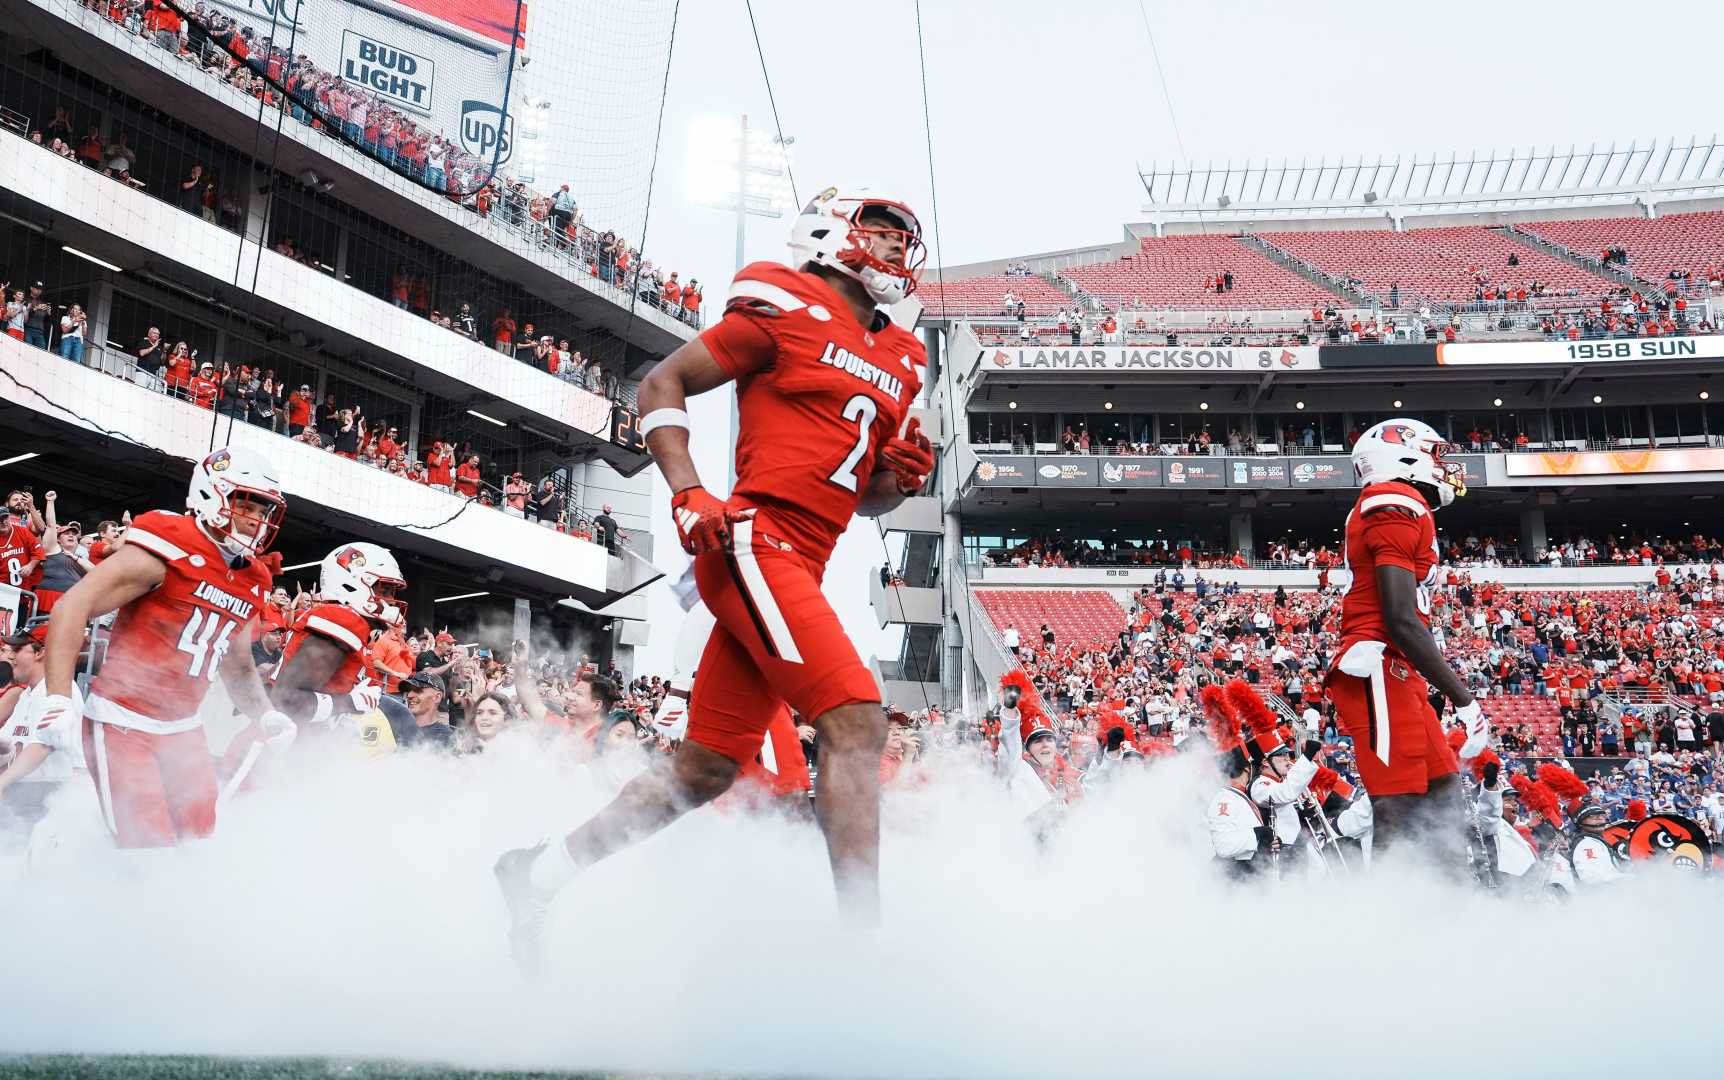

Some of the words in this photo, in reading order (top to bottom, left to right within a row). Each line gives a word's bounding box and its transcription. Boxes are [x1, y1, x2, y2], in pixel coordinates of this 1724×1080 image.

[249, 0, 305, 26] NC
[359, 39, 418, 76] BUD
[345, 58, 426, 104] LIGHT
[1018, 350, 1107, 368] LAMAR
[1114, 350, 1233, 368] JACKSON
[1258, 350, 1273, 368] 8
[1567, 343, 1631, 359] 1958
[1641, 340, 1696, 356] SUN
[828, 394, 878, 494] 2
[7, 557, 23, 587] 8
[192, 579, 255, 620] LOUISVILLE
